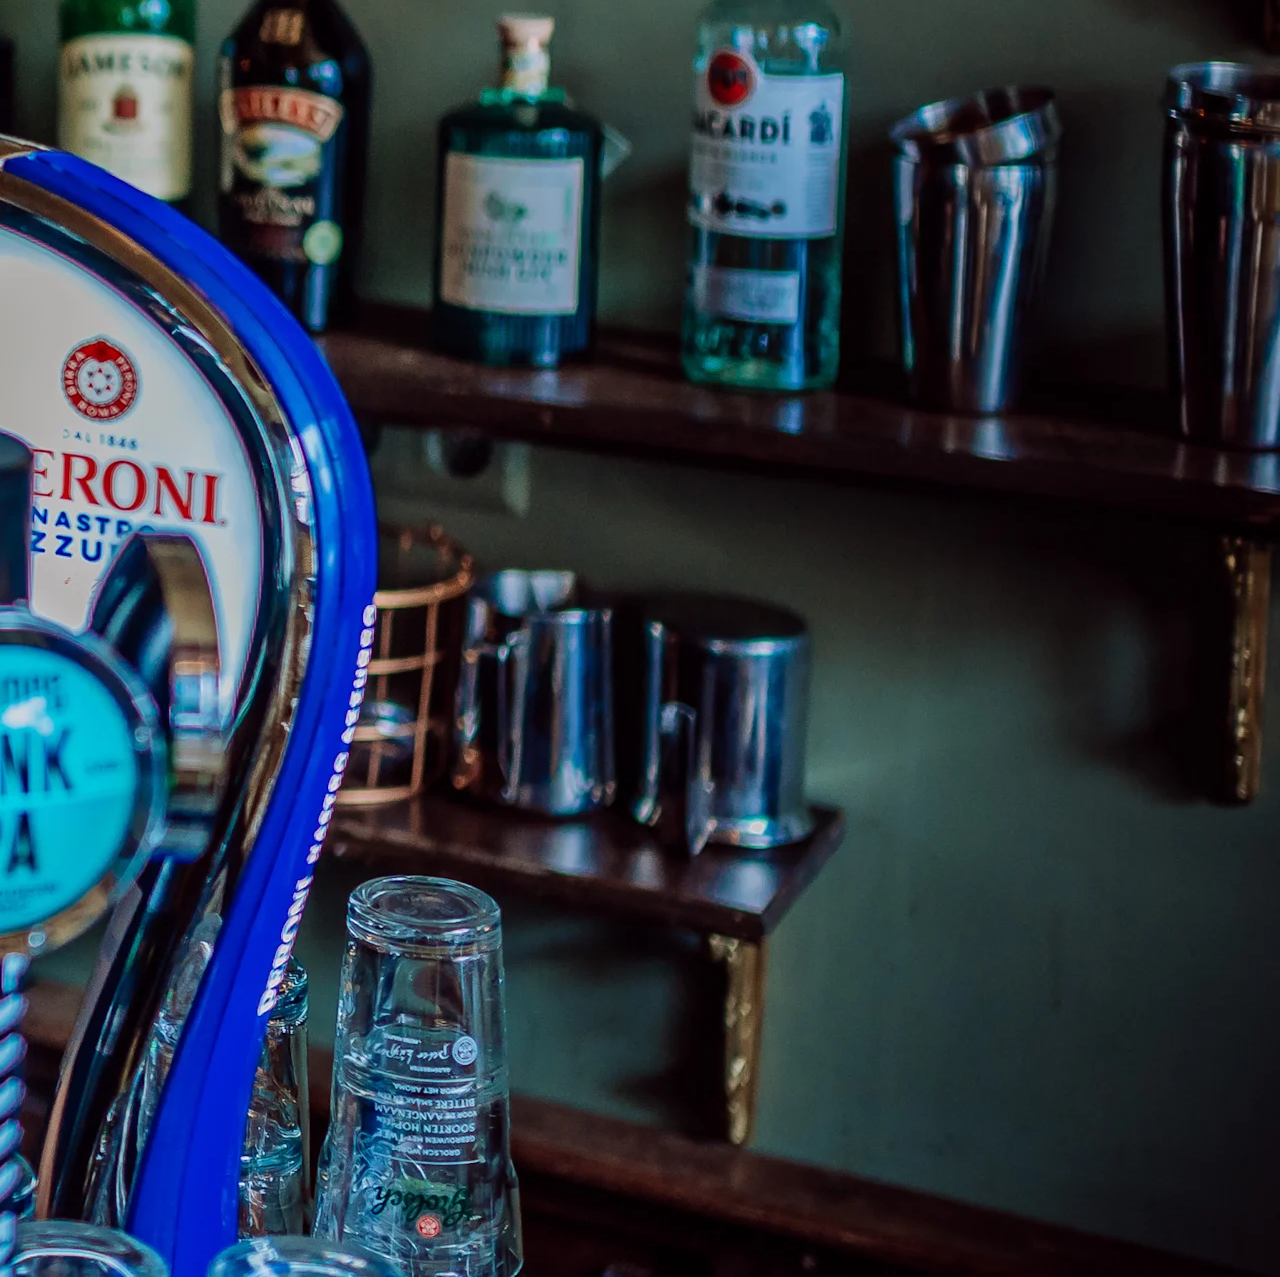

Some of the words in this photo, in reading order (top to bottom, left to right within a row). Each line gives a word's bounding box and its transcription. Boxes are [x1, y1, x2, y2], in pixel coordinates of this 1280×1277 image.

[64, 351, 87, 396] BIRRA
[115, 356, 135, 406] PERONI
[77, 400, 120, 418] ROMA
[32, 448, 218, 525] ERONI
[256, 874, 314, 1017] PERONI
[374, 1102, 445, 1121] AANGENAAM
[434, 1098, 475, 1110] BITTERE
[423, 1123, 475, 1134] SOORTEN
[370, 1185, 474, 1228] Grolsch
